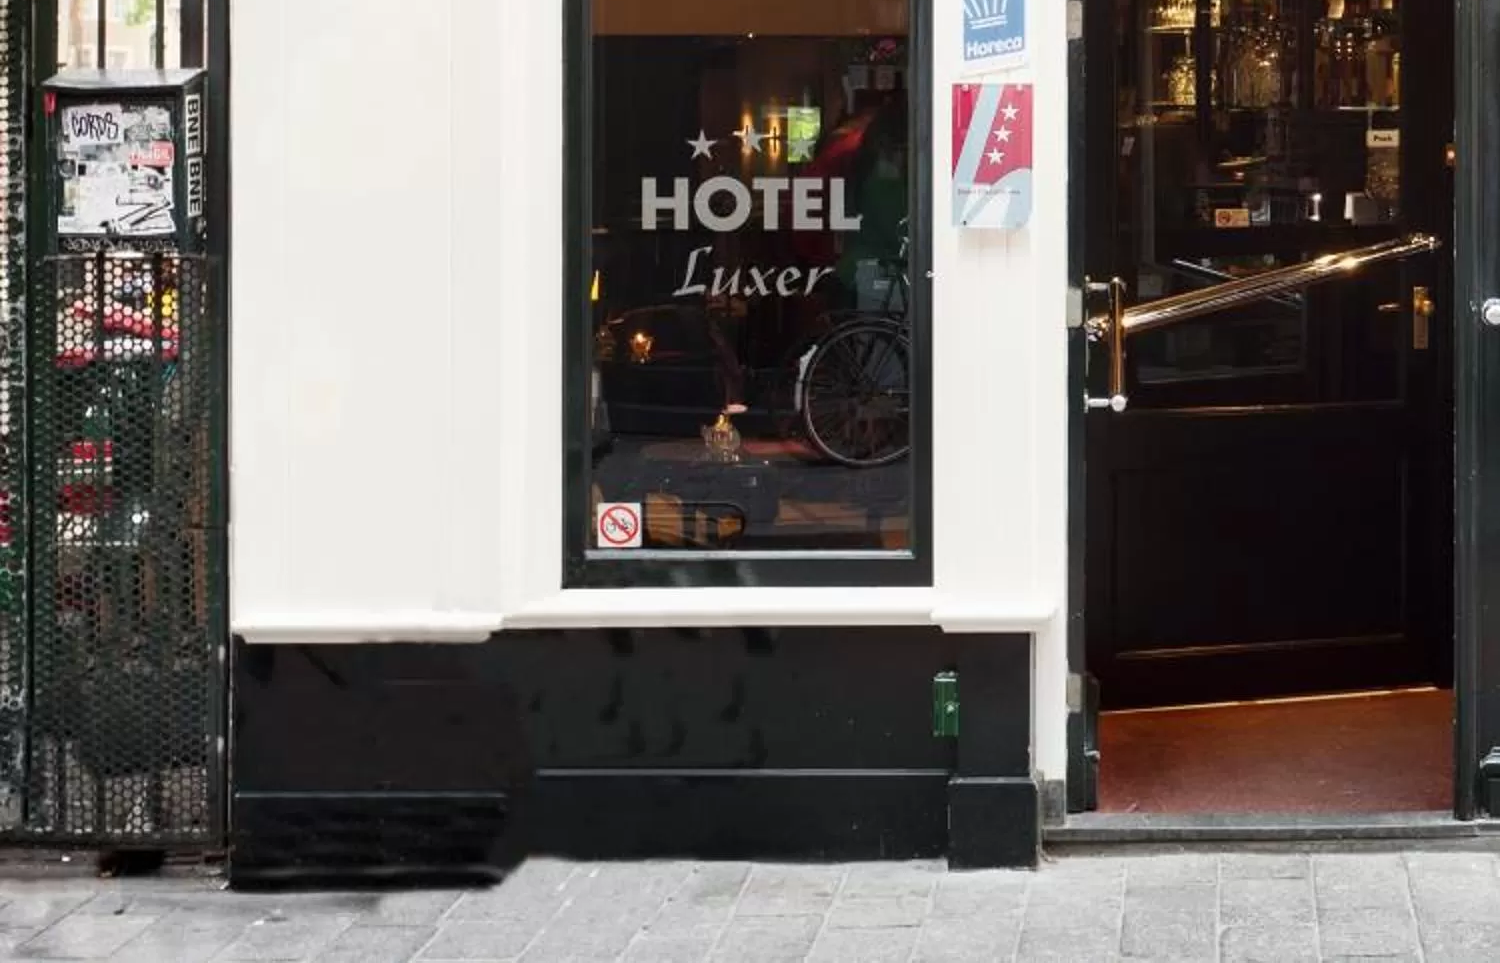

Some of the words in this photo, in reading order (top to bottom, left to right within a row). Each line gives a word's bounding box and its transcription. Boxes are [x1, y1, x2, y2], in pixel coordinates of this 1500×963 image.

[966, 36, 1023, 59] Horeca
[189, 162, 201, 215] BNE
[641, 175, 862, 232] HOTEL
[672, 245, 835, 297] Luxer
